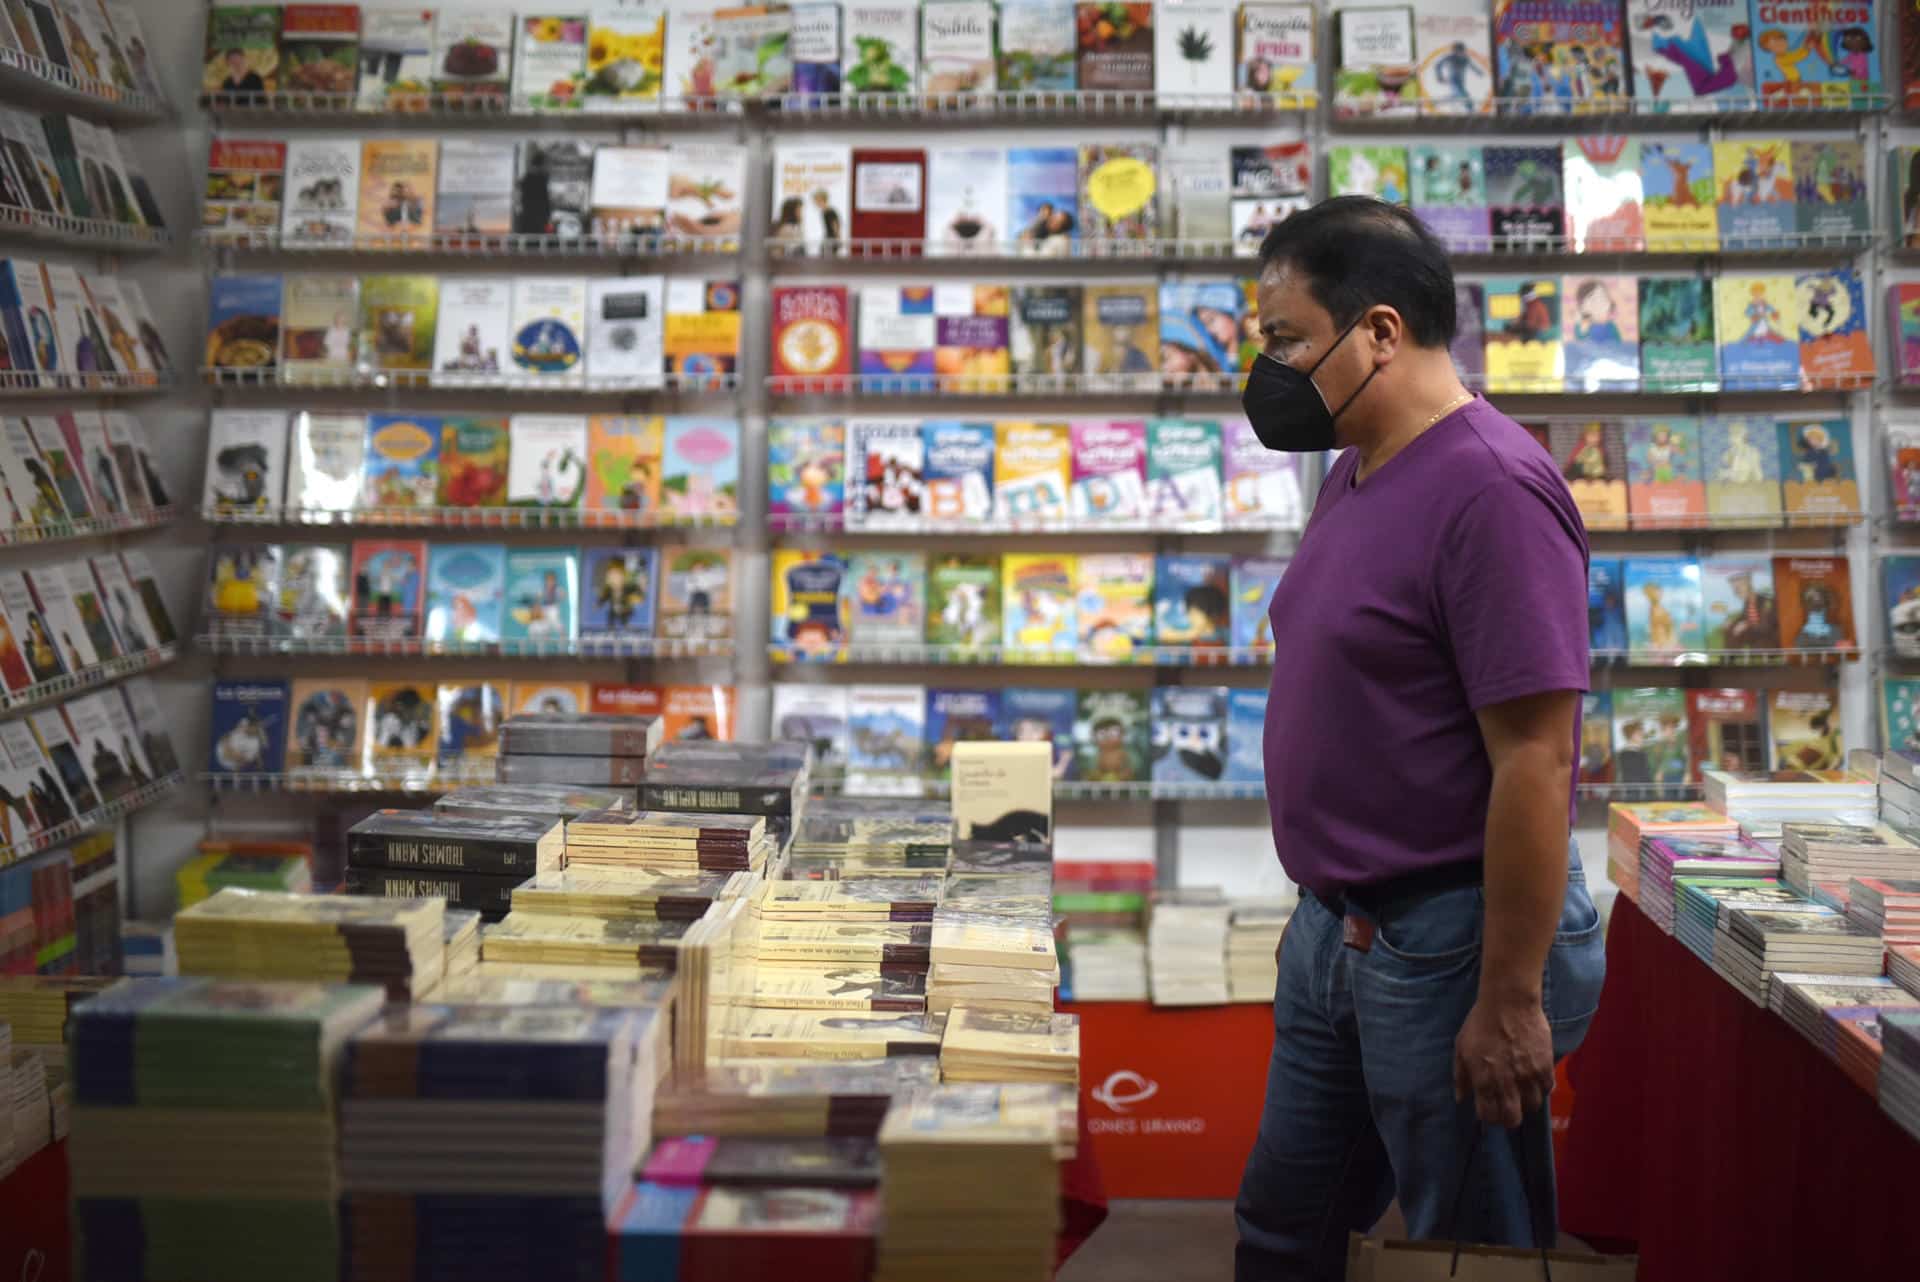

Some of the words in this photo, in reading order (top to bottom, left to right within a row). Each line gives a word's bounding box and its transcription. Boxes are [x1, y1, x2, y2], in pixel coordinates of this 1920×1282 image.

[1759, 6, 1869, 24] Científicos
[387, 841, 418, 864] MANN
[422, 844, 465, 866] THOMAS
[384, 879, 415, 900] MANN
[419, 880, 461, 902] THOMAS
[1140, 1118, 1205, 1133] URANO
